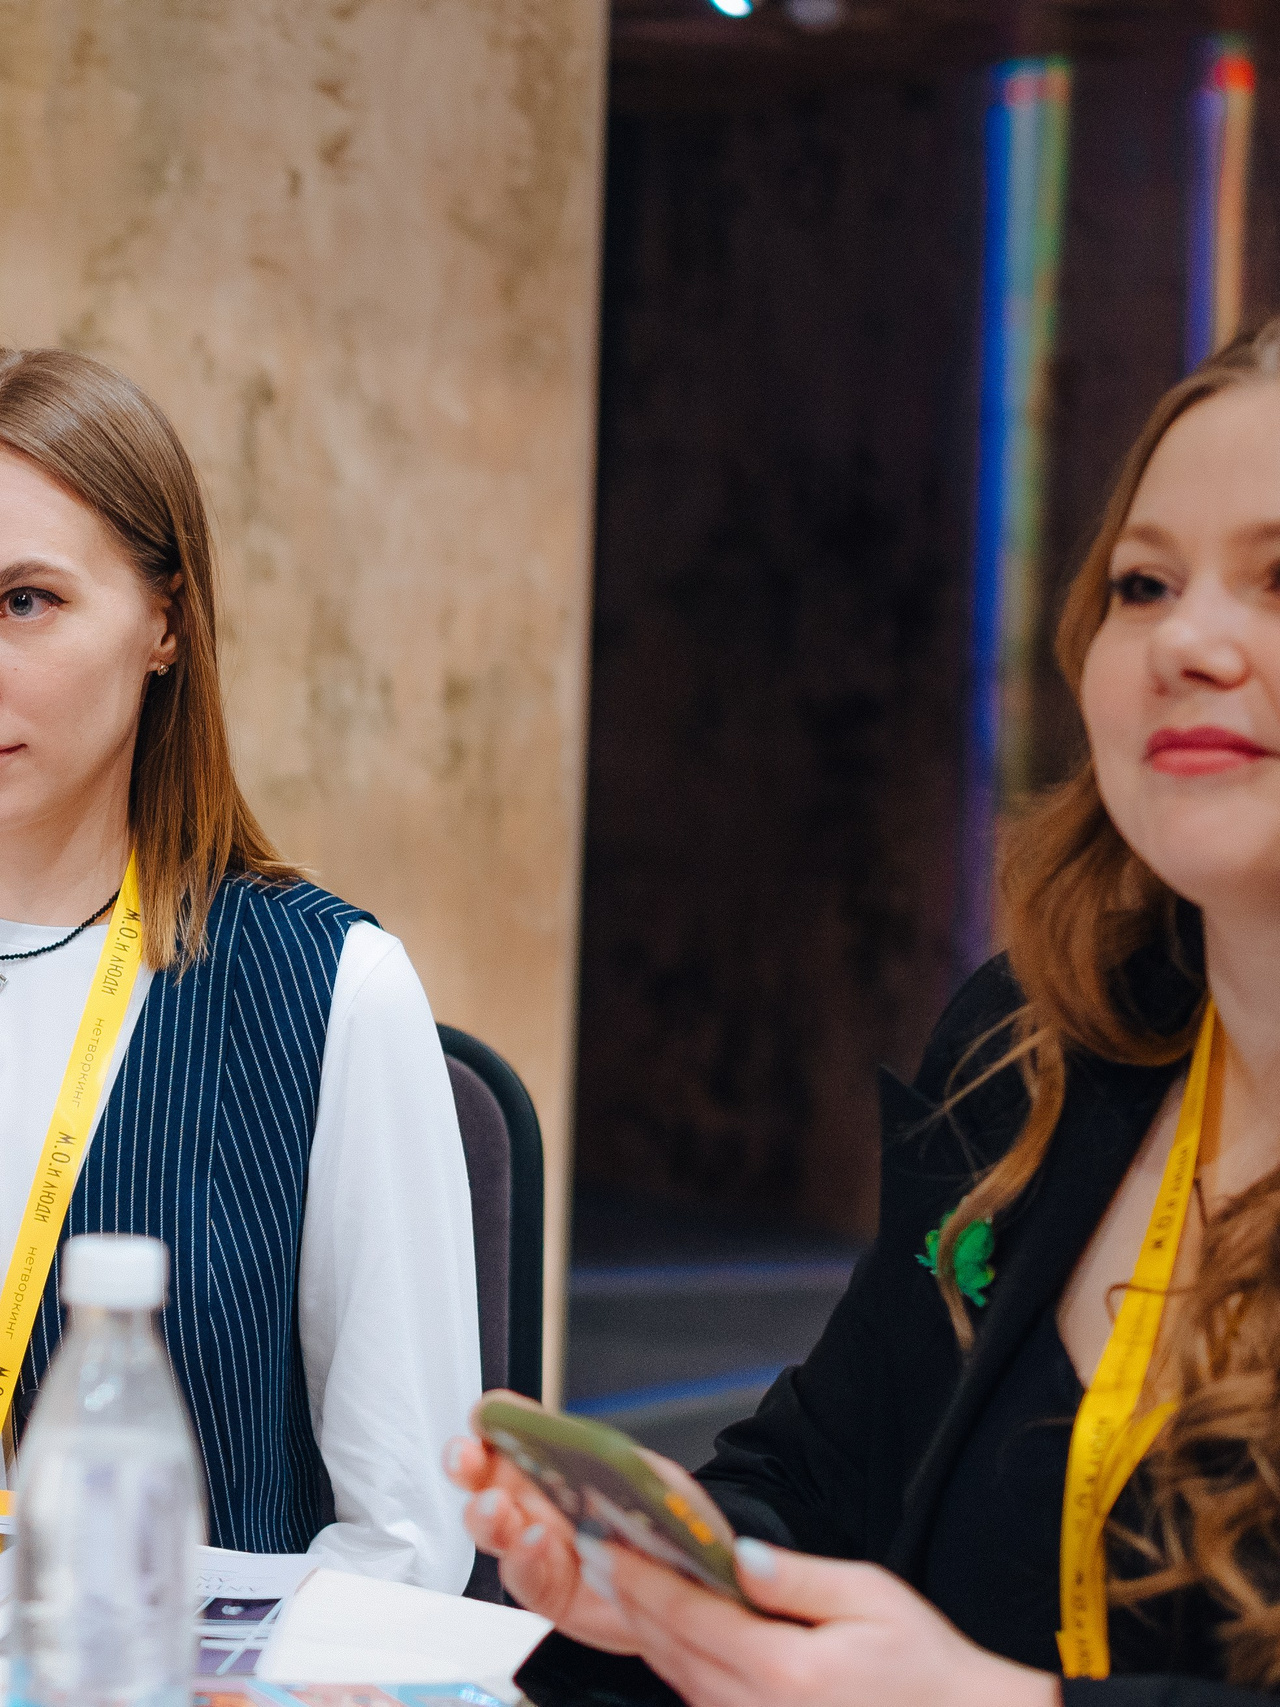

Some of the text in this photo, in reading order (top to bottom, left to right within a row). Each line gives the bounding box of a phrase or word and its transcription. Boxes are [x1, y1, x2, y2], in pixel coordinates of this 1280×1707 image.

[101, 954, 126, 996] ЛЮДИ
[72, 1017, 105, 1108] нетворкинг
[34, 1180, 58, 1223] ЛЮДИ
[6, 1246, 37, 1340] нетворкинг
